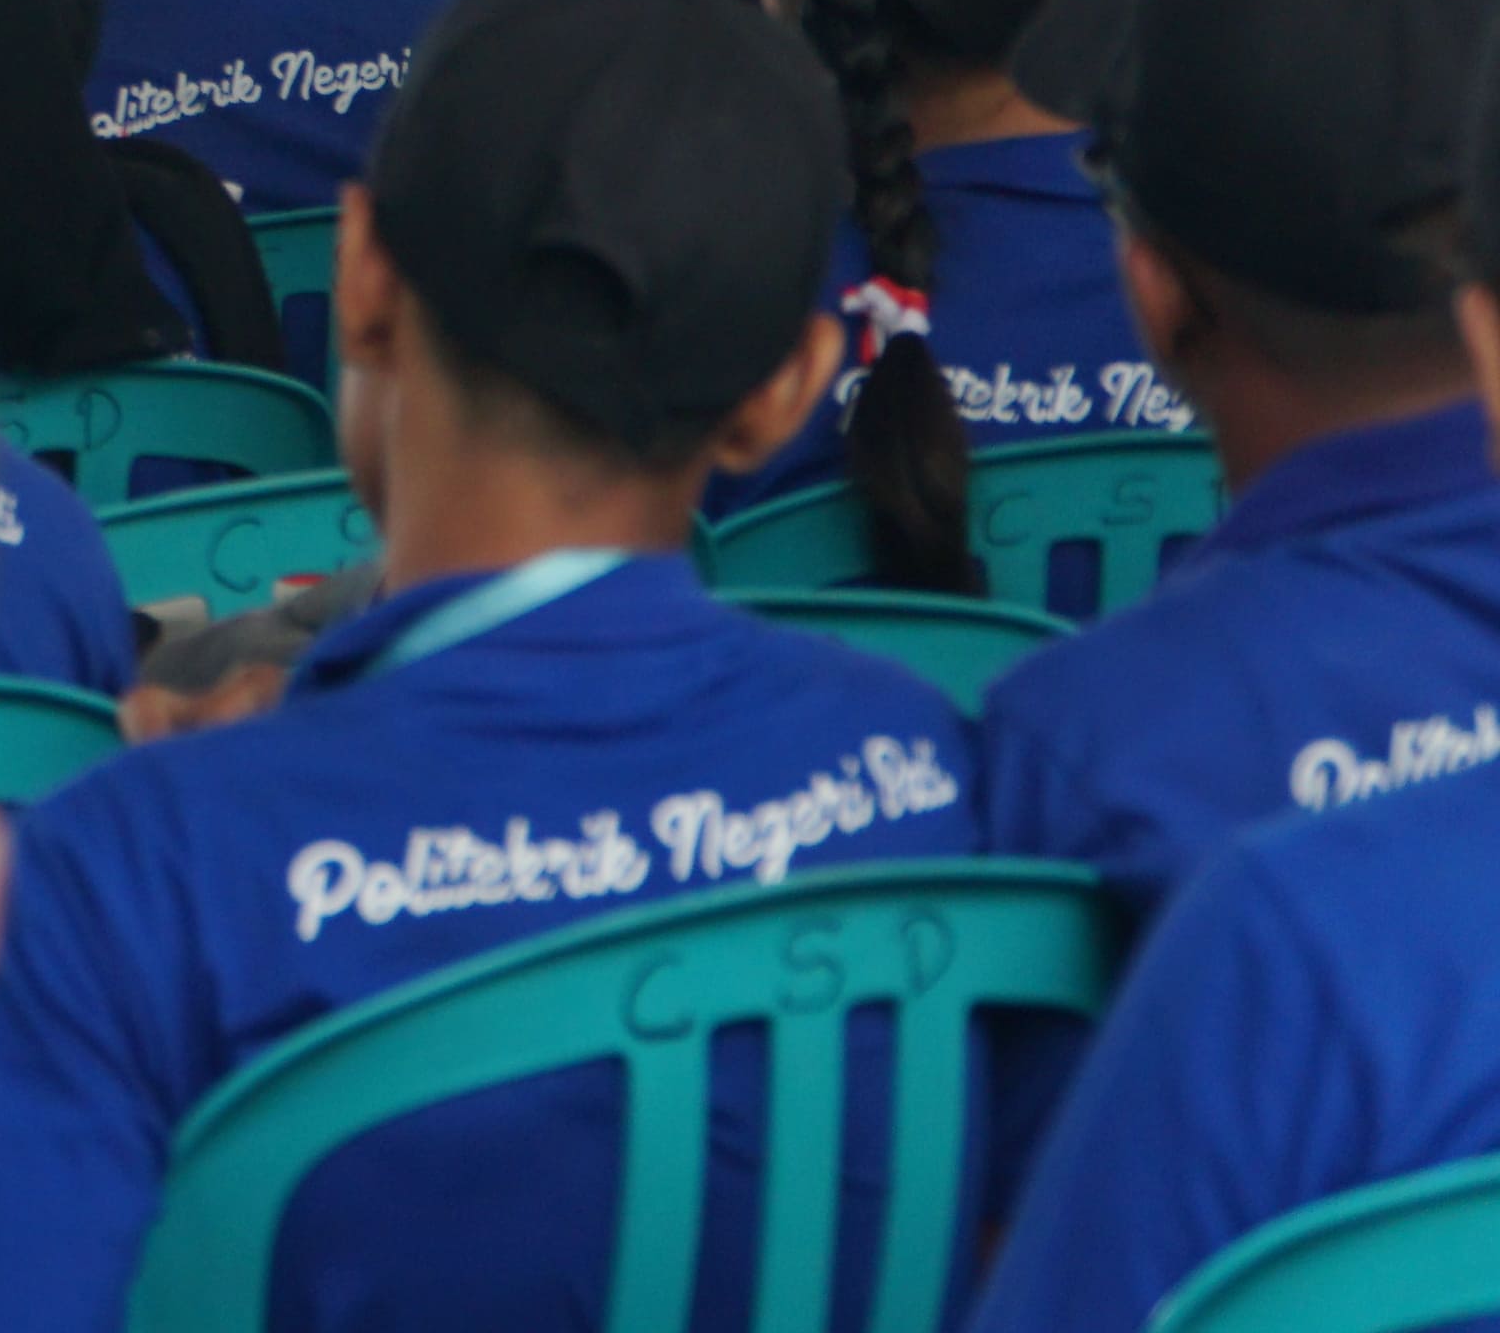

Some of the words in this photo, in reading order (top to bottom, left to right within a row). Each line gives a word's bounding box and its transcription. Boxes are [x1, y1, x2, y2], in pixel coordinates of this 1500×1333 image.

[90, 59, 262, 139] oliteknik
[287, 815, 651, 942] Politeknik
[650, 757, 874, 886] Negeri
